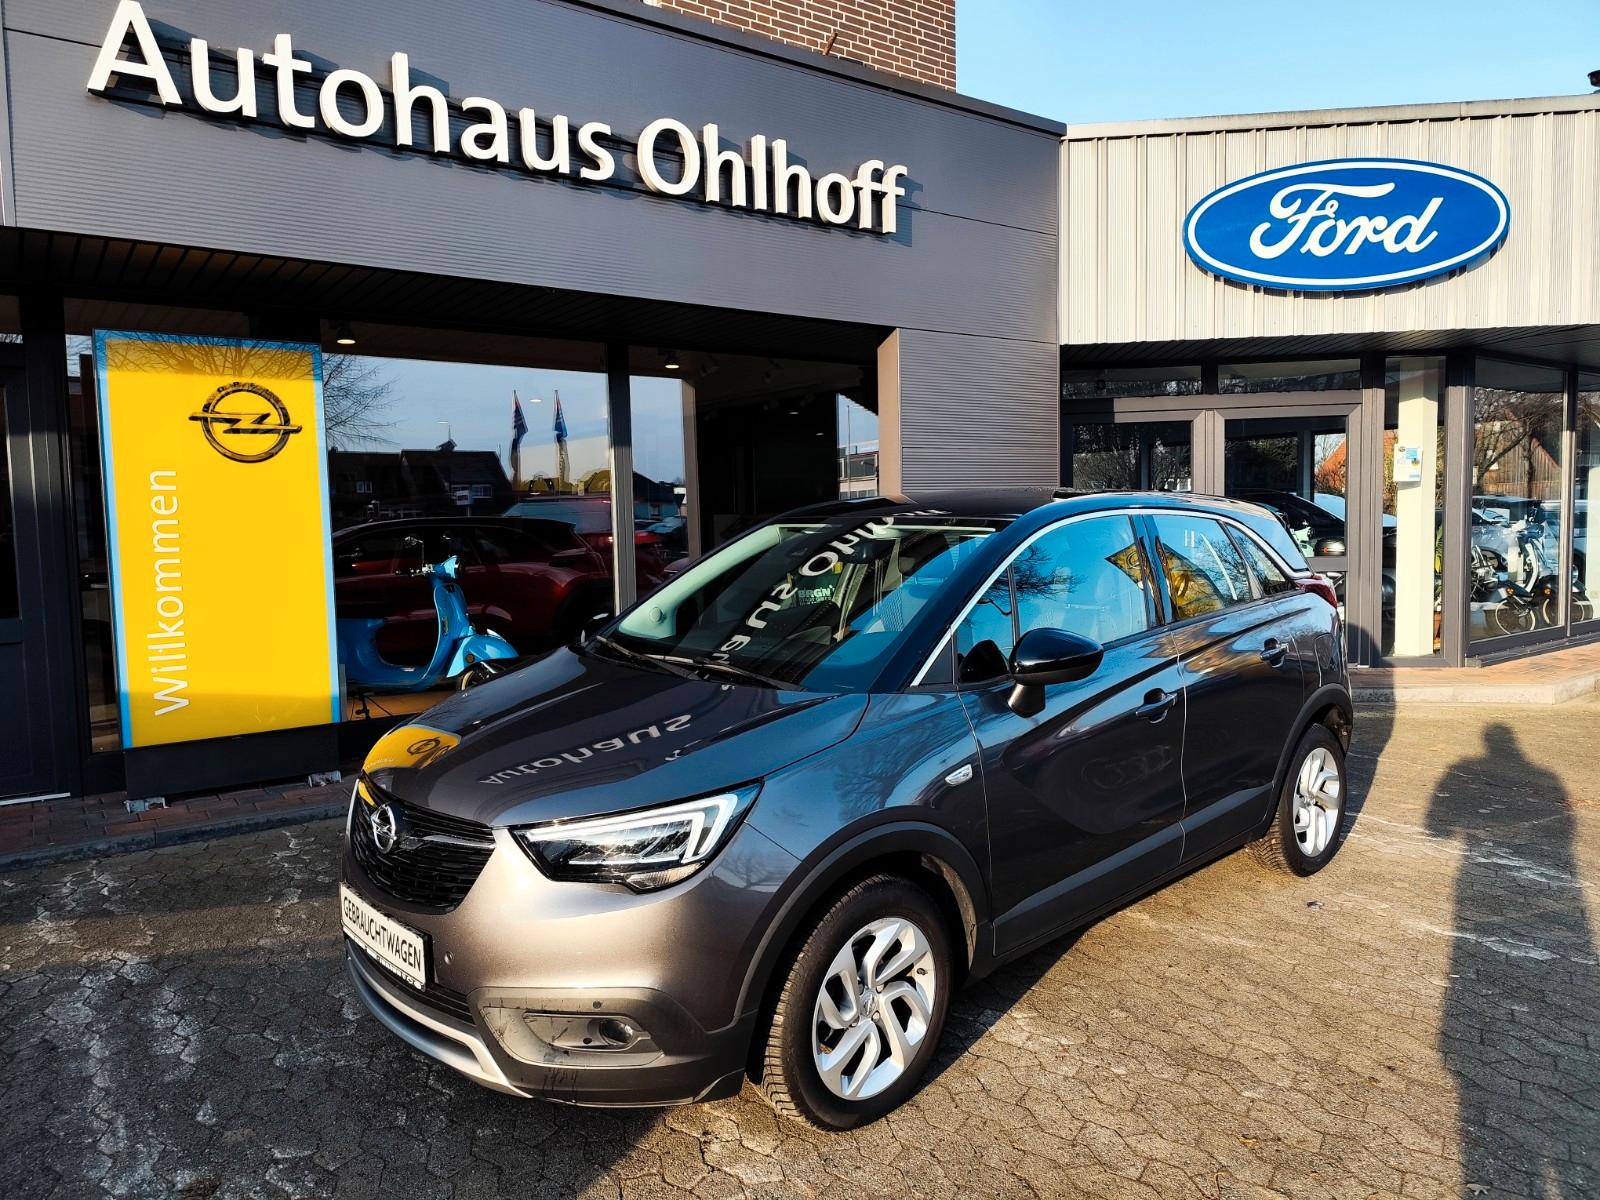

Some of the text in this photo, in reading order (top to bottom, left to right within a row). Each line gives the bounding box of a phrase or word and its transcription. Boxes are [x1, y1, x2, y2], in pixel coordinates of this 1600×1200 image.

[87, 0, 908, 234] Autohaus Ohlhoff
[1249, 182, 1444, 259] Ford
[147, 469, 190, 717] Willkommen
[343, 896, 421, 972] GEBRAUCHTWAGEN
